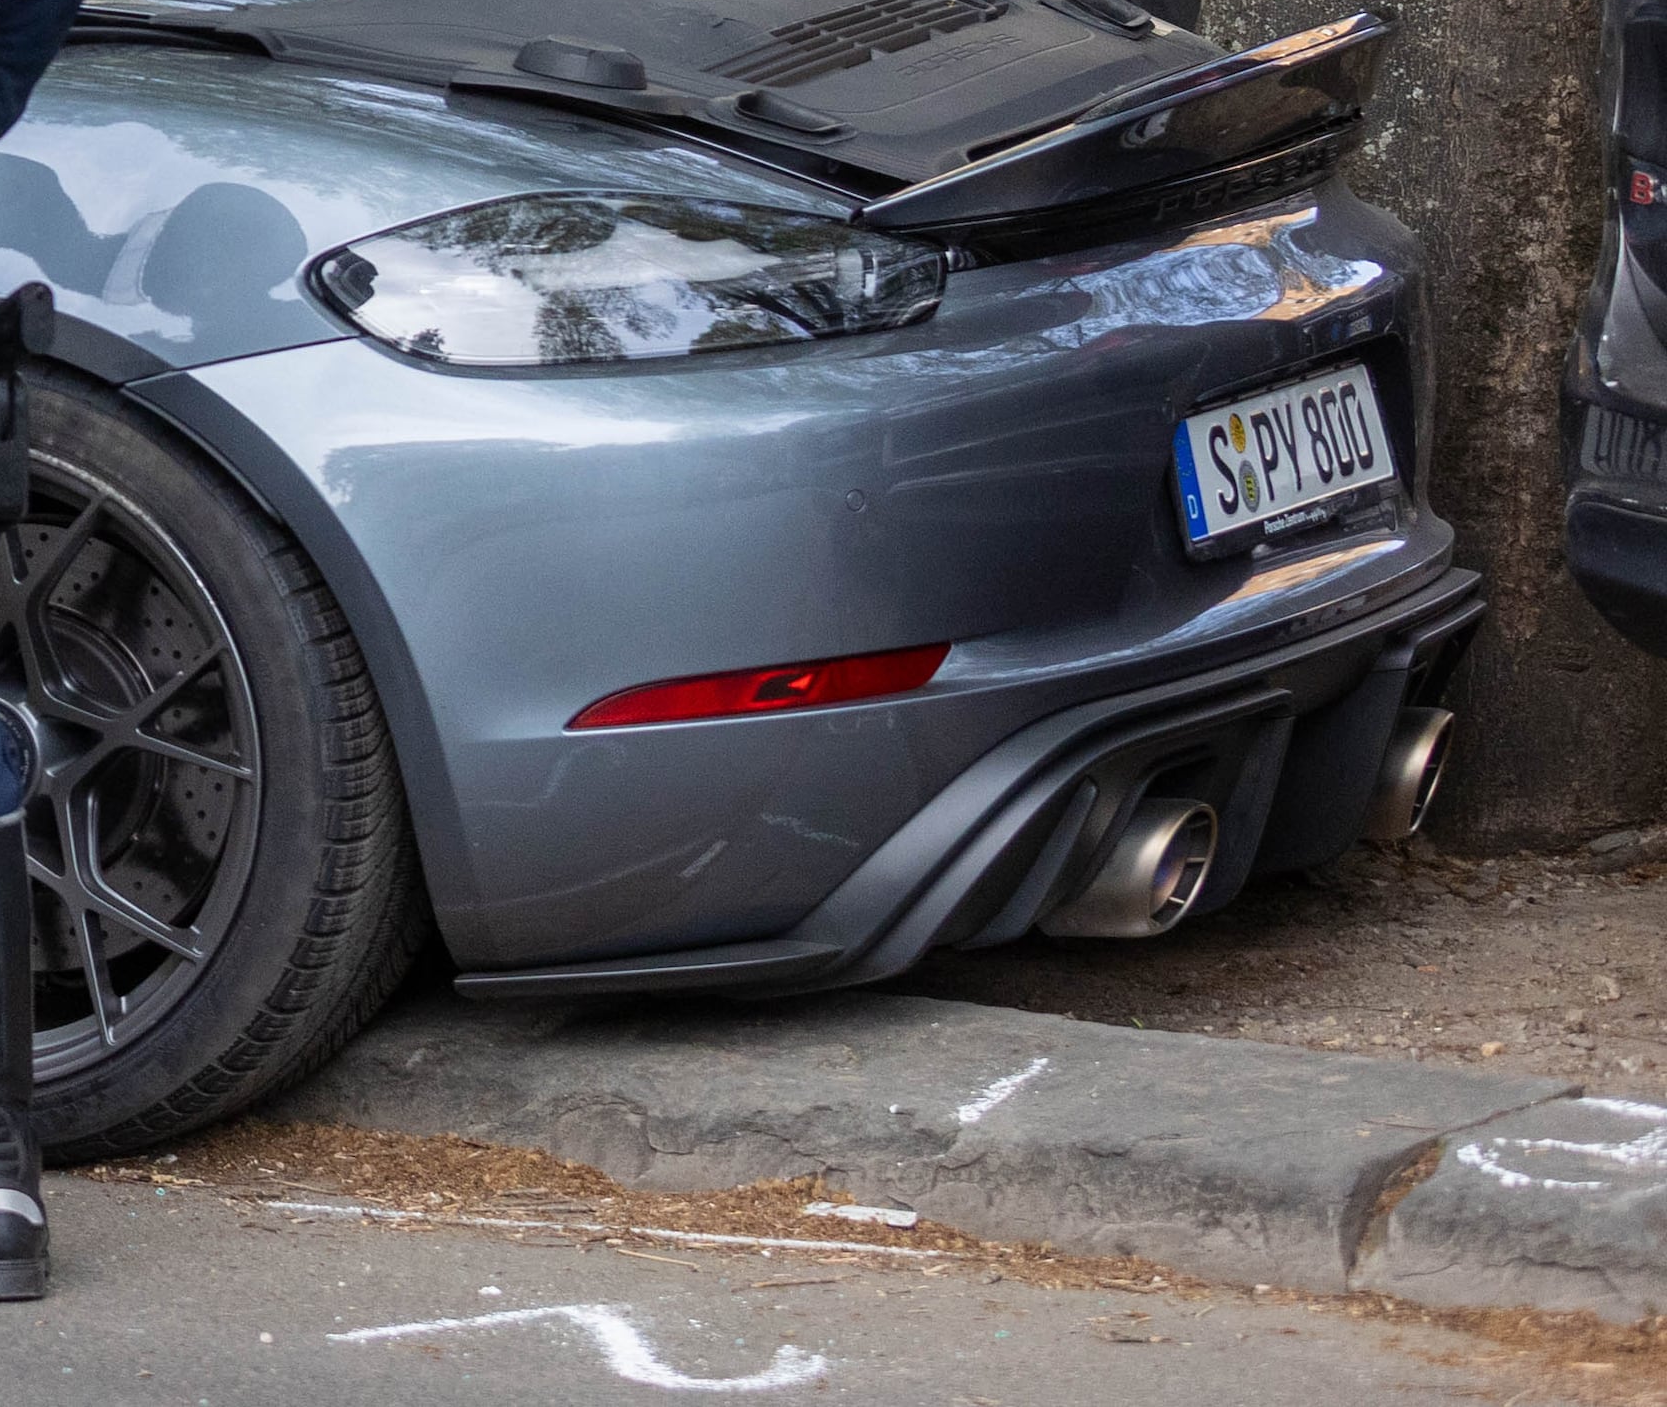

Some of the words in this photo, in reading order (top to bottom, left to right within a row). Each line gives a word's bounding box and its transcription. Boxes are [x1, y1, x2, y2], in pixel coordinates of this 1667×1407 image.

[1249, 402, 1303, 502] PY
[1301, 380, 1374, 485] 800
[1186, 494, 1199, 520] D
